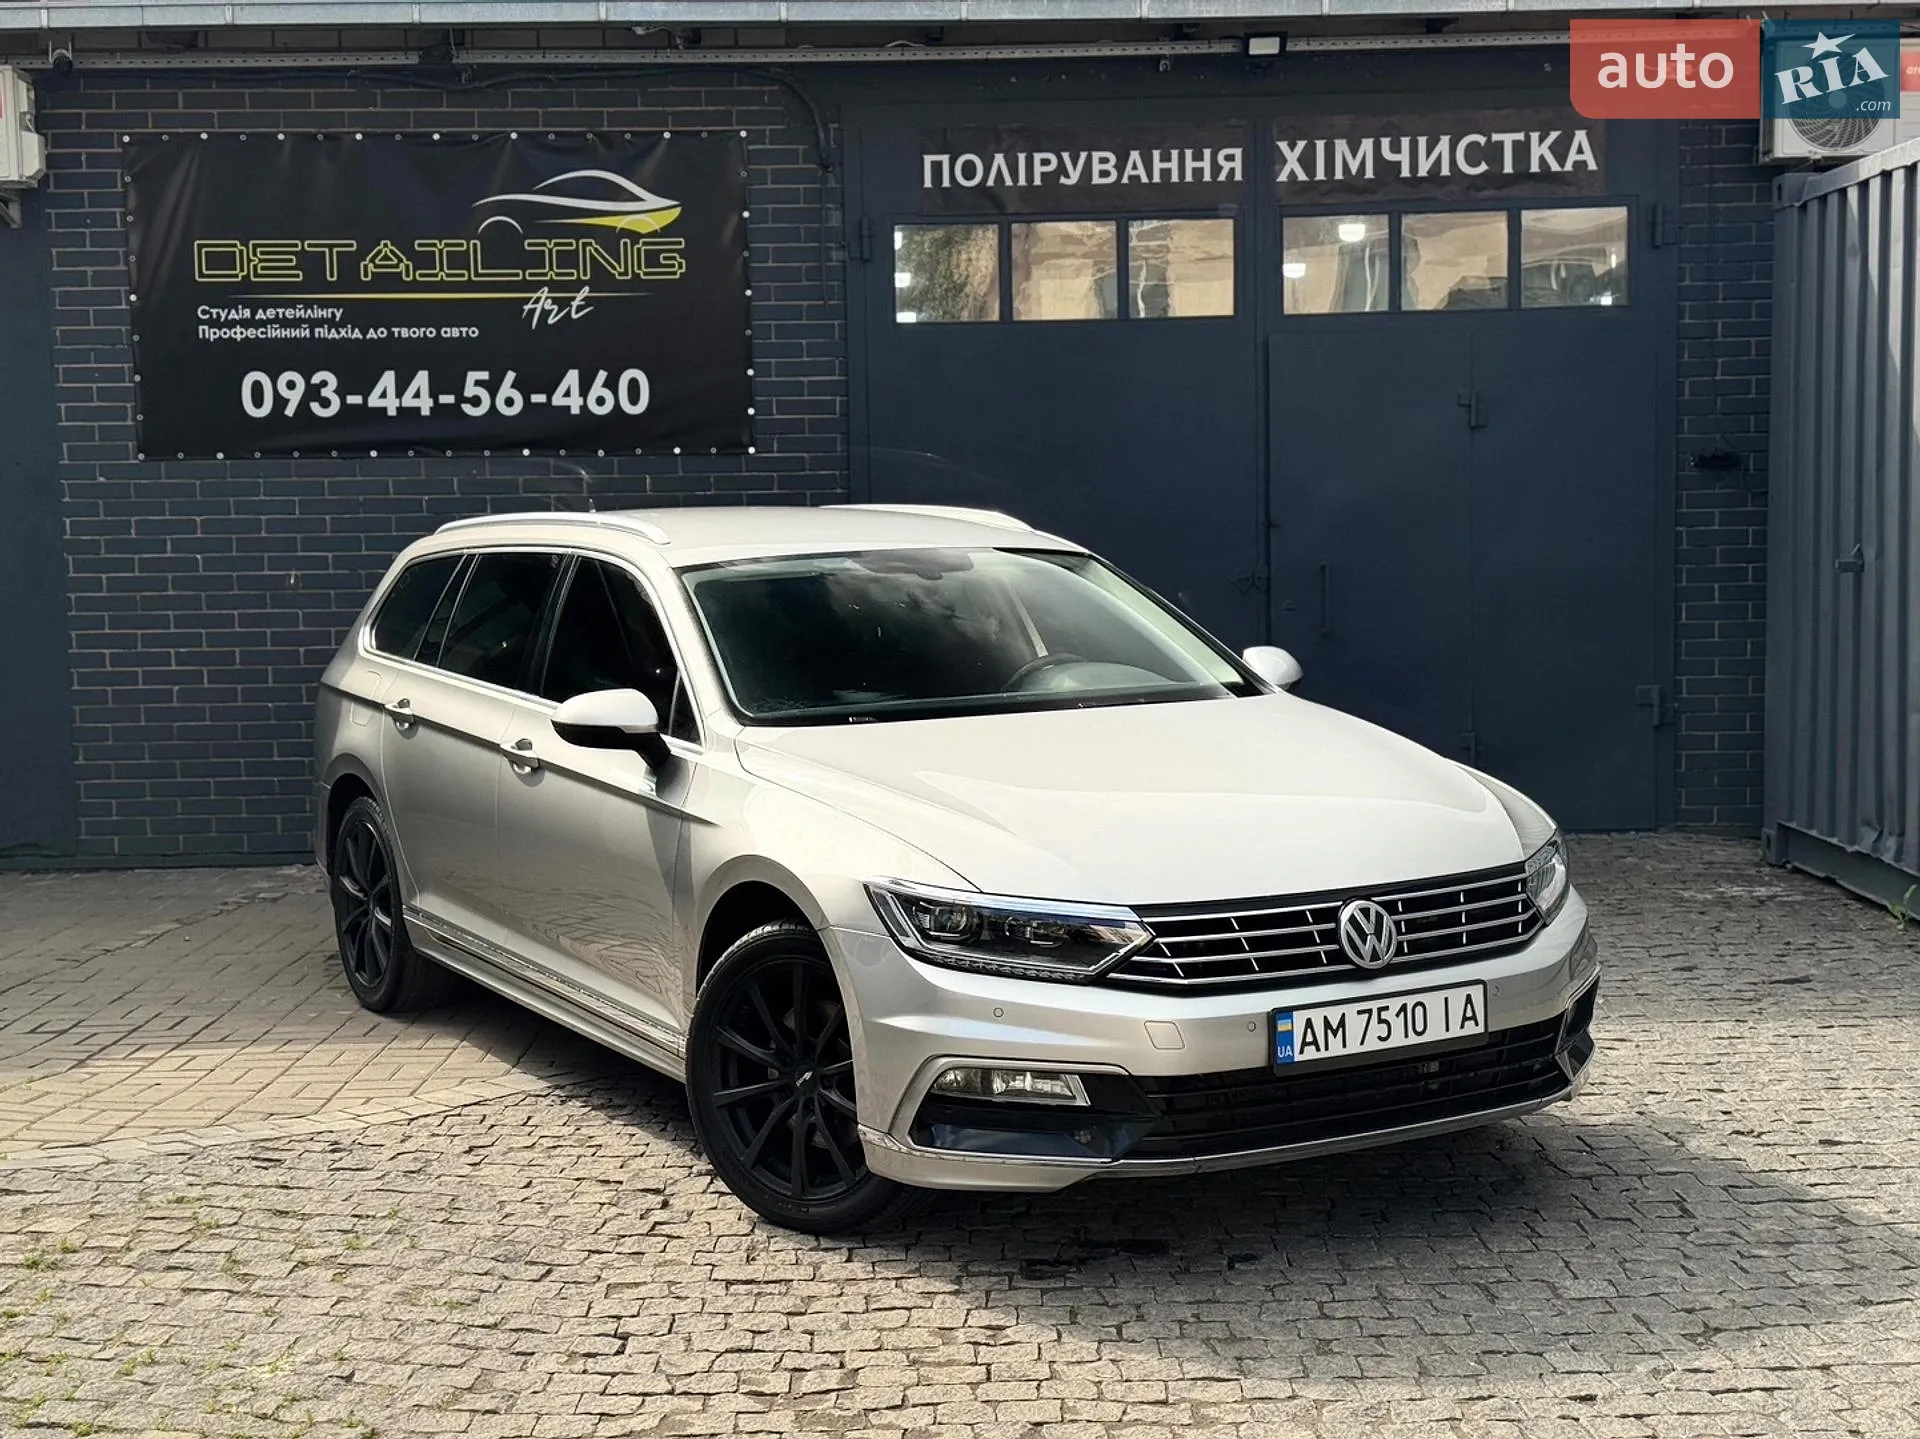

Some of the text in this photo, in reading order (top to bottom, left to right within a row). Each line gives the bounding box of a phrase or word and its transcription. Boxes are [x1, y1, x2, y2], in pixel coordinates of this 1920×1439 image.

[922, 147, 1243, 189] ПОЛІРУВАННЯ
[1276, 129, 1599, 183] ХІМЧИСТКА
[194, 238, 686, 282] DETAILING
[197, 304, 343, 322] Студія детейлінгу
[521, 286, 595, 330] Art
[198, 324, 480, 341] Професійний підхід до твого авто
[240, 368, 650, 418] 093-44-56-460
[1299, 1012, 1347, 1056] AM
[1357, 1001, 1428, 1047] 7510
[1277, 1045, 1293, 1058] UA
